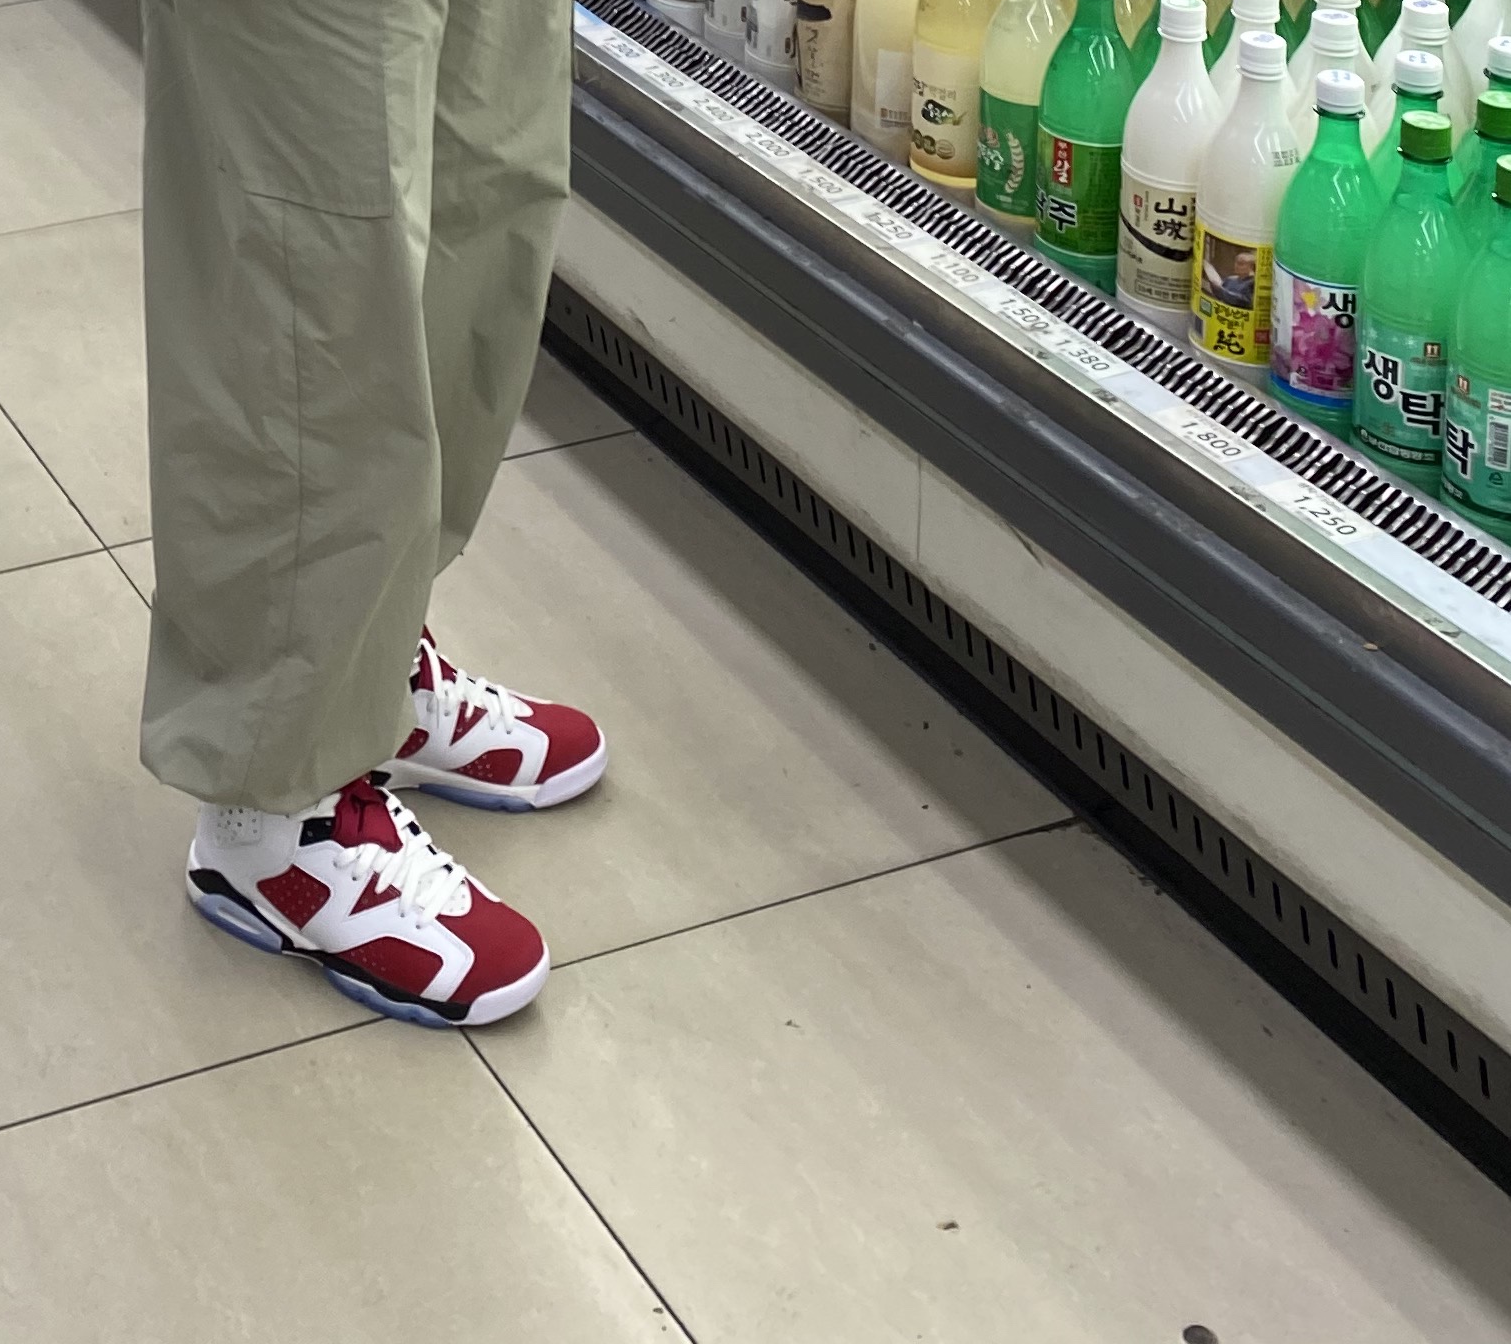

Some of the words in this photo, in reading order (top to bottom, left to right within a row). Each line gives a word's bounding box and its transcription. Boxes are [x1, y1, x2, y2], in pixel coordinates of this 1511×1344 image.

[798, 167, 842, 195] 1,500
[931, 253, 980, 283] 1,100
[1000, 298, 1049, 331] 1,500
[1322, 292, 1356, 329] 생
[1055, 338, 1110, 372] 1,380
[1181, 422, 1241, 457] 1,800
[1293, 495, 1357, 537] 1,250
